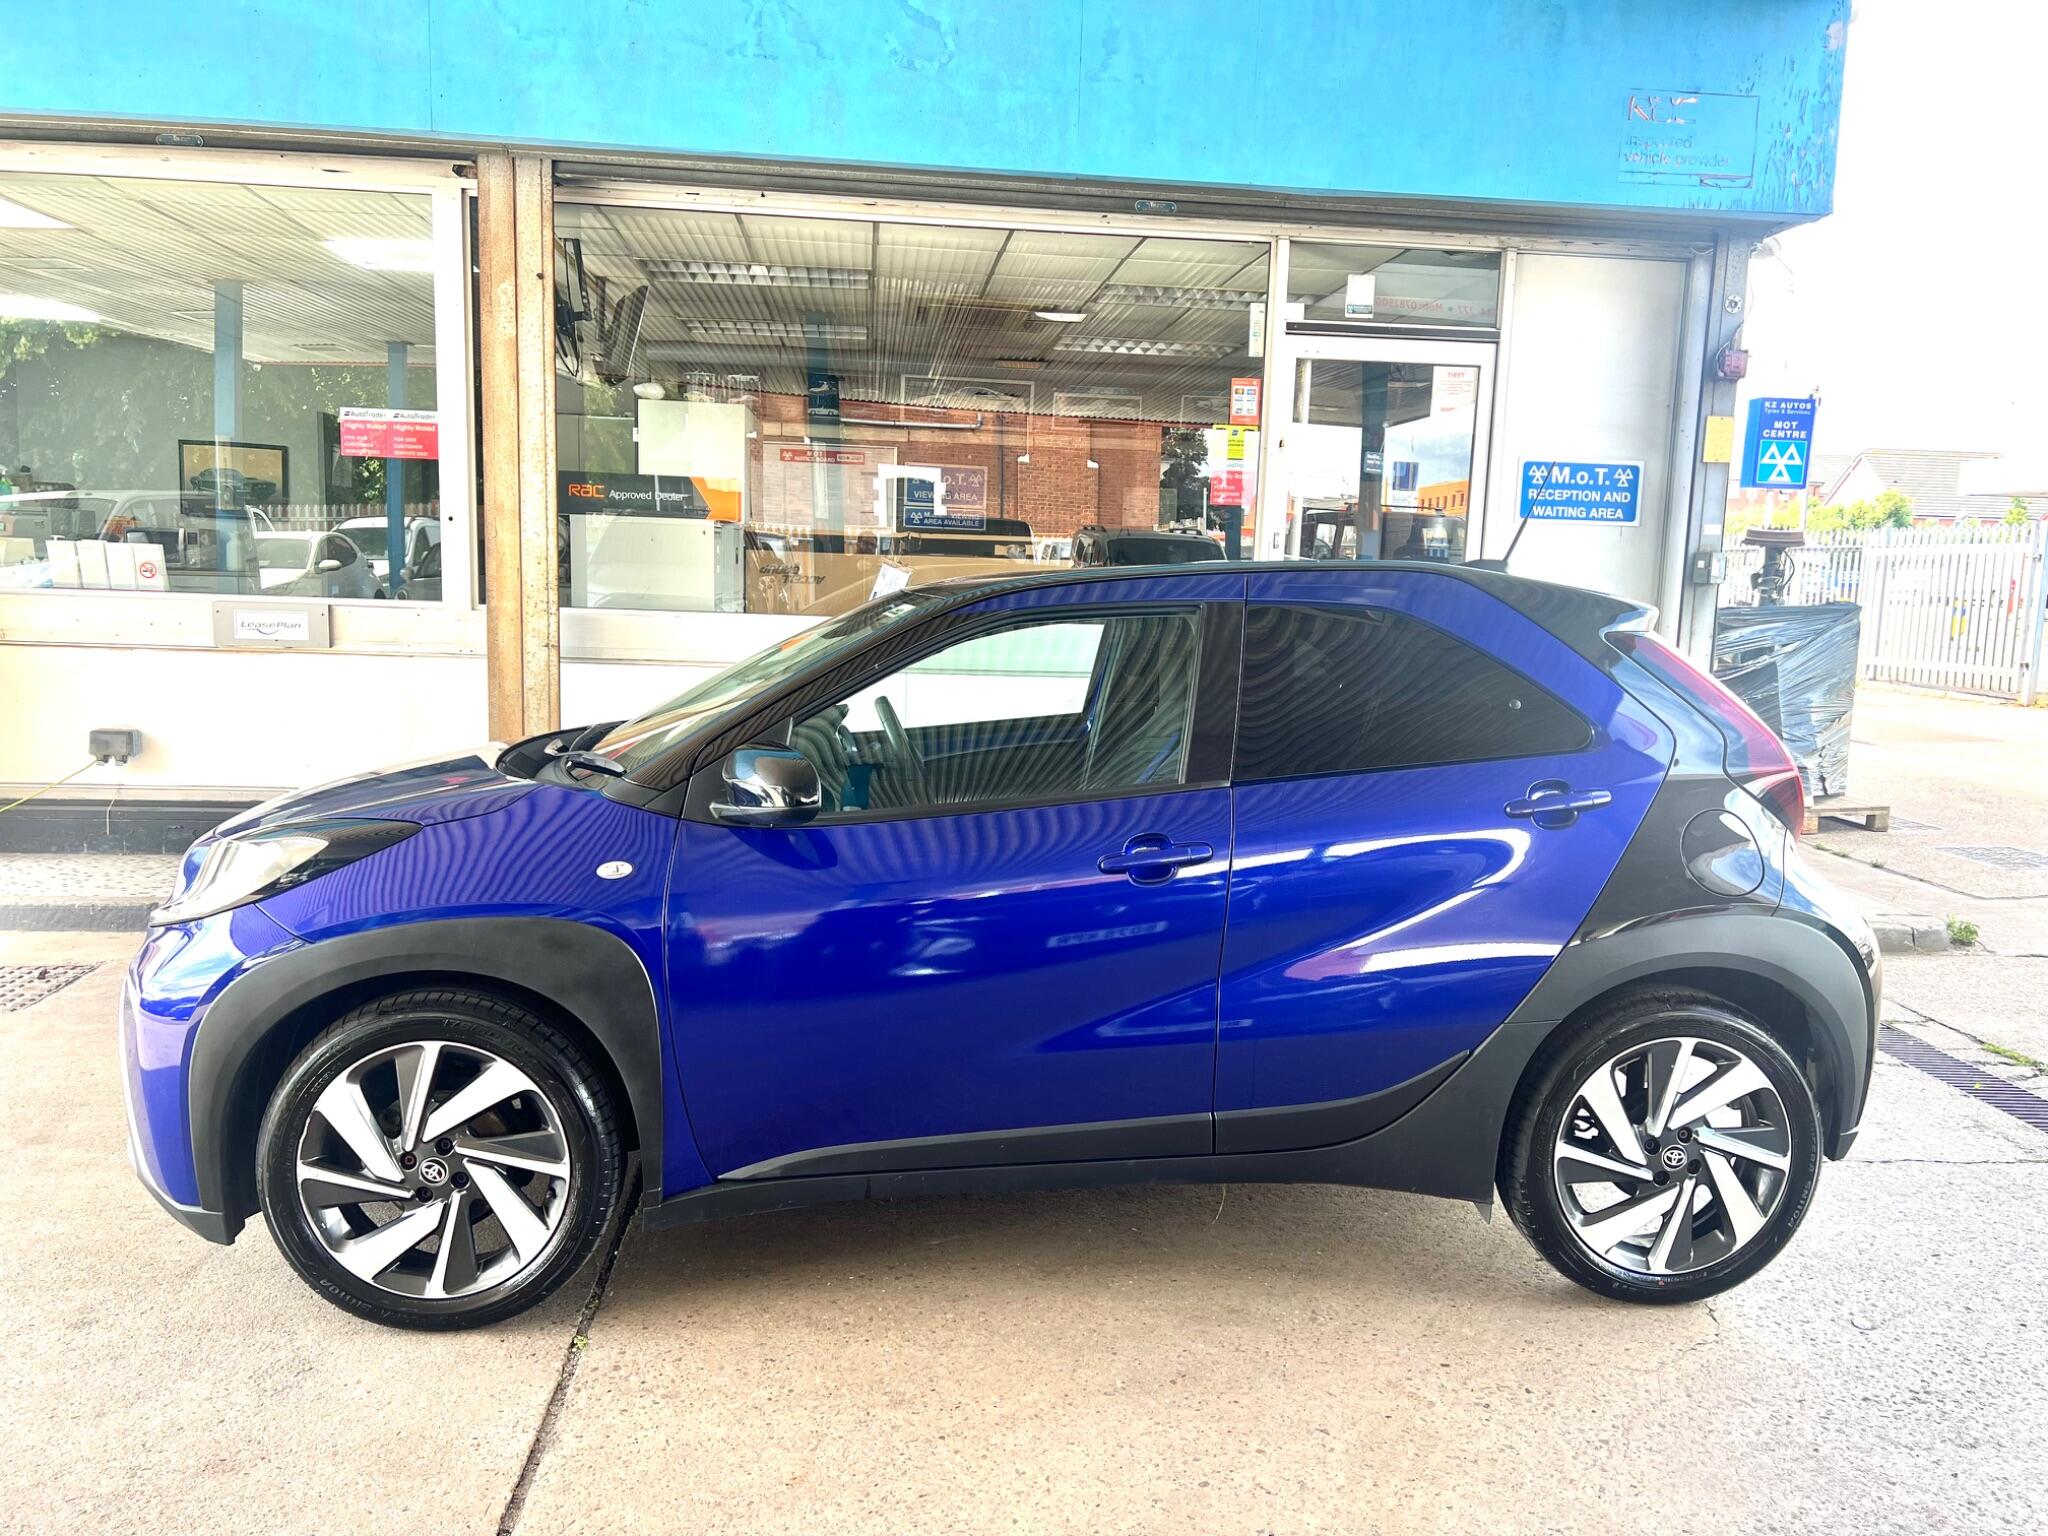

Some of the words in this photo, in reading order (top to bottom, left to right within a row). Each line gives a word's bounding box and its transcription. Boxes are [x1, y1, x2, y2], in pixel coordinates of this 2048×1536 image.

[1774, 421, 1798, 429] MOT
[1763, 430, 1807, 438] CENTRE
[1551, 466, 1610, 485] M.o.T.
[608, 489, 652, 501] Approved
[654, 491, 685, 501] Dealer
[953, 493, 978, 501] AREA
[1528, 488, 1600, 502] RECEPTION
[1603, 491, 1631, 503] AND
[1532, 505, 1587, 518] WAITING
[1589, 507, 1624, 519] AREA
[943, 519, 980, 527] AVAILABLE
[240, 620, 302, 629] LeasePlan
